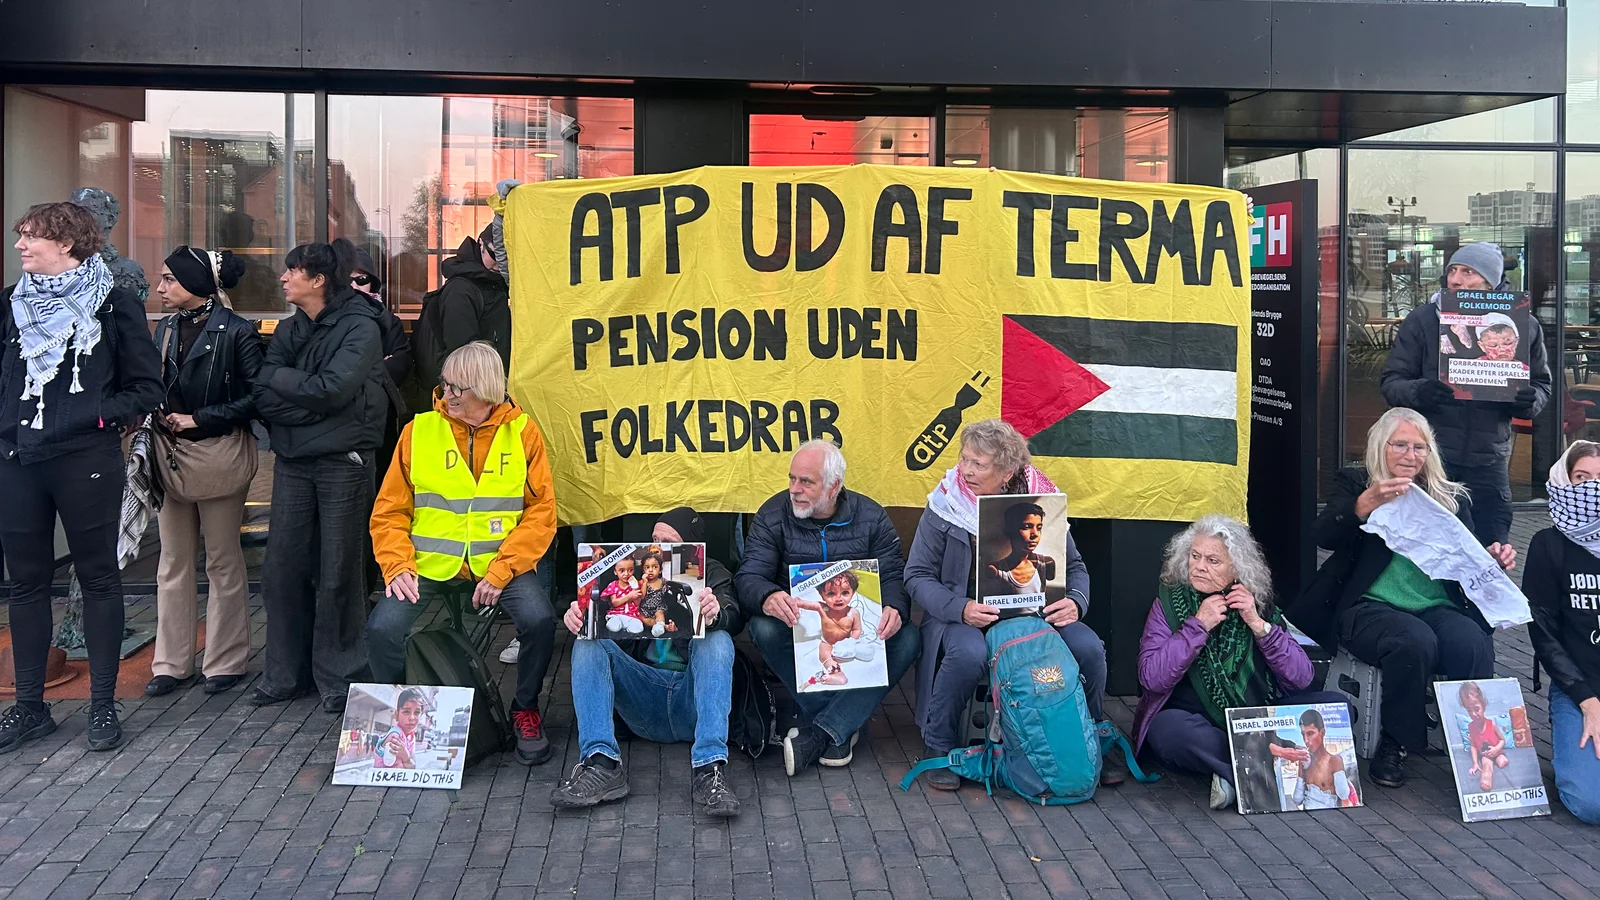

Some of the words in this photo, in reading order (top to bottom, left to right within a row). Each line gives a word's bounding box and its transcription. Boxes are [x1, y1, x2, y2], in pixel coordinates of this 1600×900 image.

[570, 184, 710, 286] ATP
[741, 181, 846, 273] UD
[871, 184, 972, 275] AF
[1003, 190, 1243, 287] TERMA
[1248, 214, 1287, 257] FH
[1251, 272, 1287, 281] GBEVÆGELSENS
[1251, 283, 1291, 291] EDORGANISATION
[1456, 291, 1485, 300] ISRAEL
[1486, 291, 1515, 301] BEGÅR
[1459, 301, 1512, 311] FOLKEMORD
[1265, 310, 1282, 320] Brygge
[1256, 322, 1275, 337] 32D
[571, 307, 788, 371] PENSION
[807, 307, 918, 361] UDEN
[1449, 360, 1510, 369] FORBRÆNDINGER
[1449, 368, 1476, 376] SKADER
[1476, 369, 1497, 377] EFTER
[1497, 370, 1529, 378] ISRAELSK
[1258, 375, 1273, 385] DTDA
[1449, 376, 1508, 385] BOMBARDEMENT
[1272, 416, 1283, 426] A/S
[580, 399, 843, 463] FOLKEDRAB
[913, 423, 949, 464] atp
[578, 565, 603, 583] ISRAEL
[603, 544, 632, 566] BOMBER
[797, 577, 820, 592] ISRAEL
[821, 562, 848, 580] BOMBER
[1570, 573, 1600, 590] JØD
[985, 598, 1010, 606] ISRAEL
[1012, 595, 1043, 604] BOMBER
[1570, 593, 1600, 610] RET
[1235, 721, 1261, 730] ISRAEL
[1263, 718, 1295, 728] BOMBER
[371, 770, 409, 783] ISRAEL
[1467, 793, 1503, 808] ISRAEL
